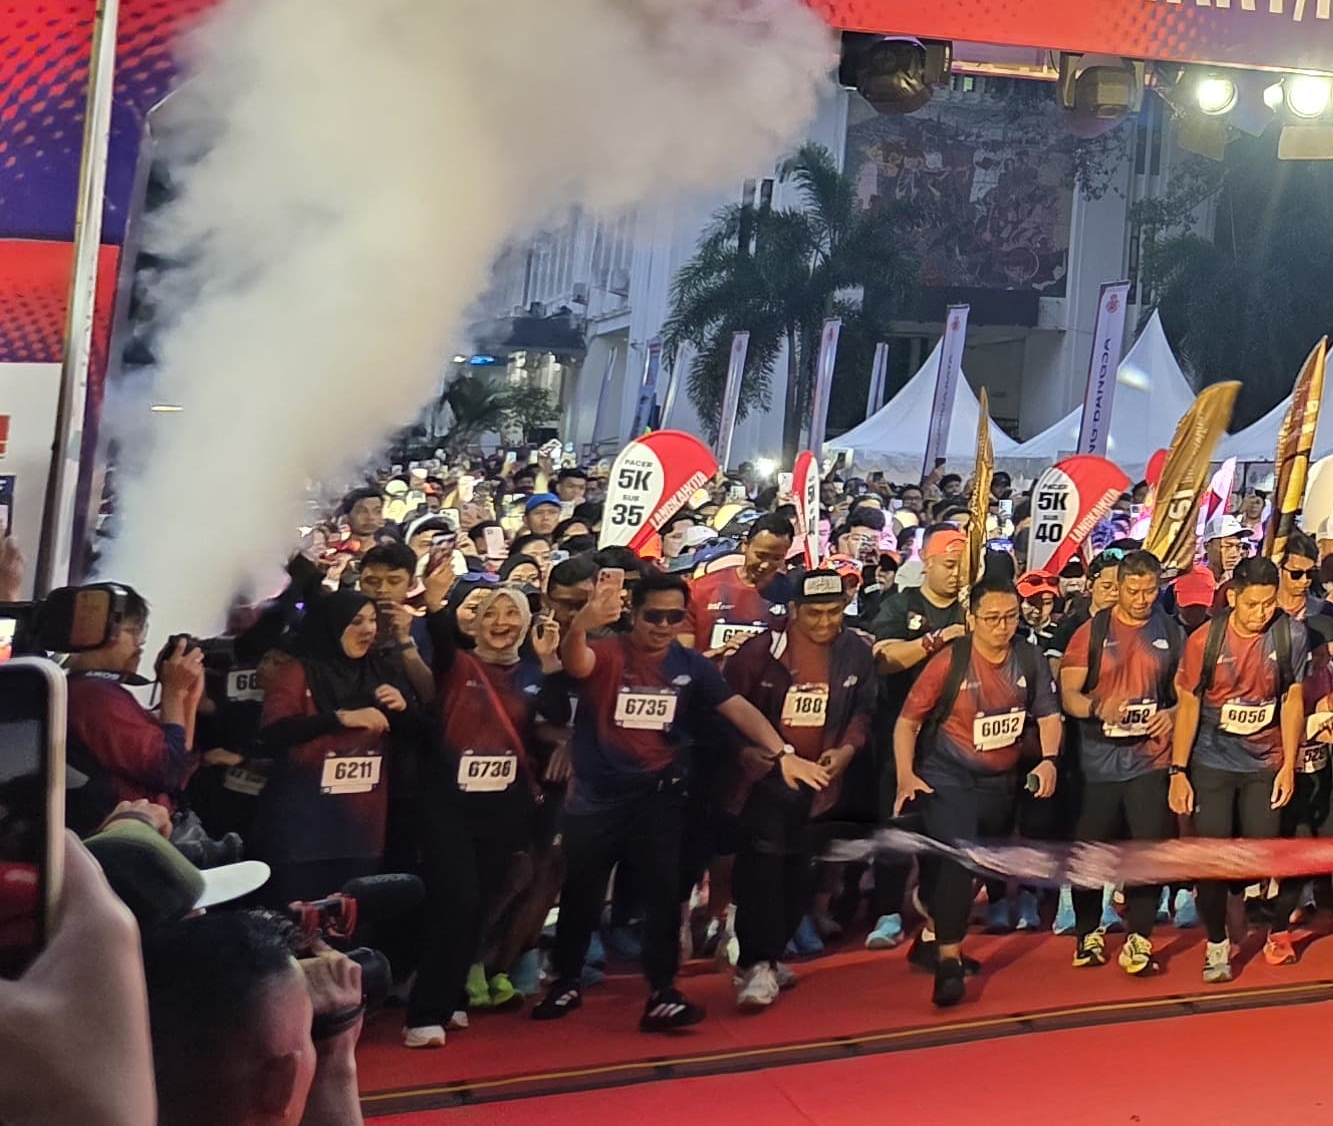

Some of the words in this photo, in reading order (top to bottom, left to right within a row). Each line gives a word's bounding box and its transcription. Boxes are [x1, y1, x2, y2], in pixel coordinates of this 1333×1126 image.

[618, 468, 652, 491] 5K
[1037, 492, 1069, 510] 5K
[611, 504, 645, 526] 35
[1035, 523, 1063, 543] 40
[625, 698, 667, 716] 6735
[982, 717, 1020, 737] 6052
[335, 761, 373, 779] 6211
